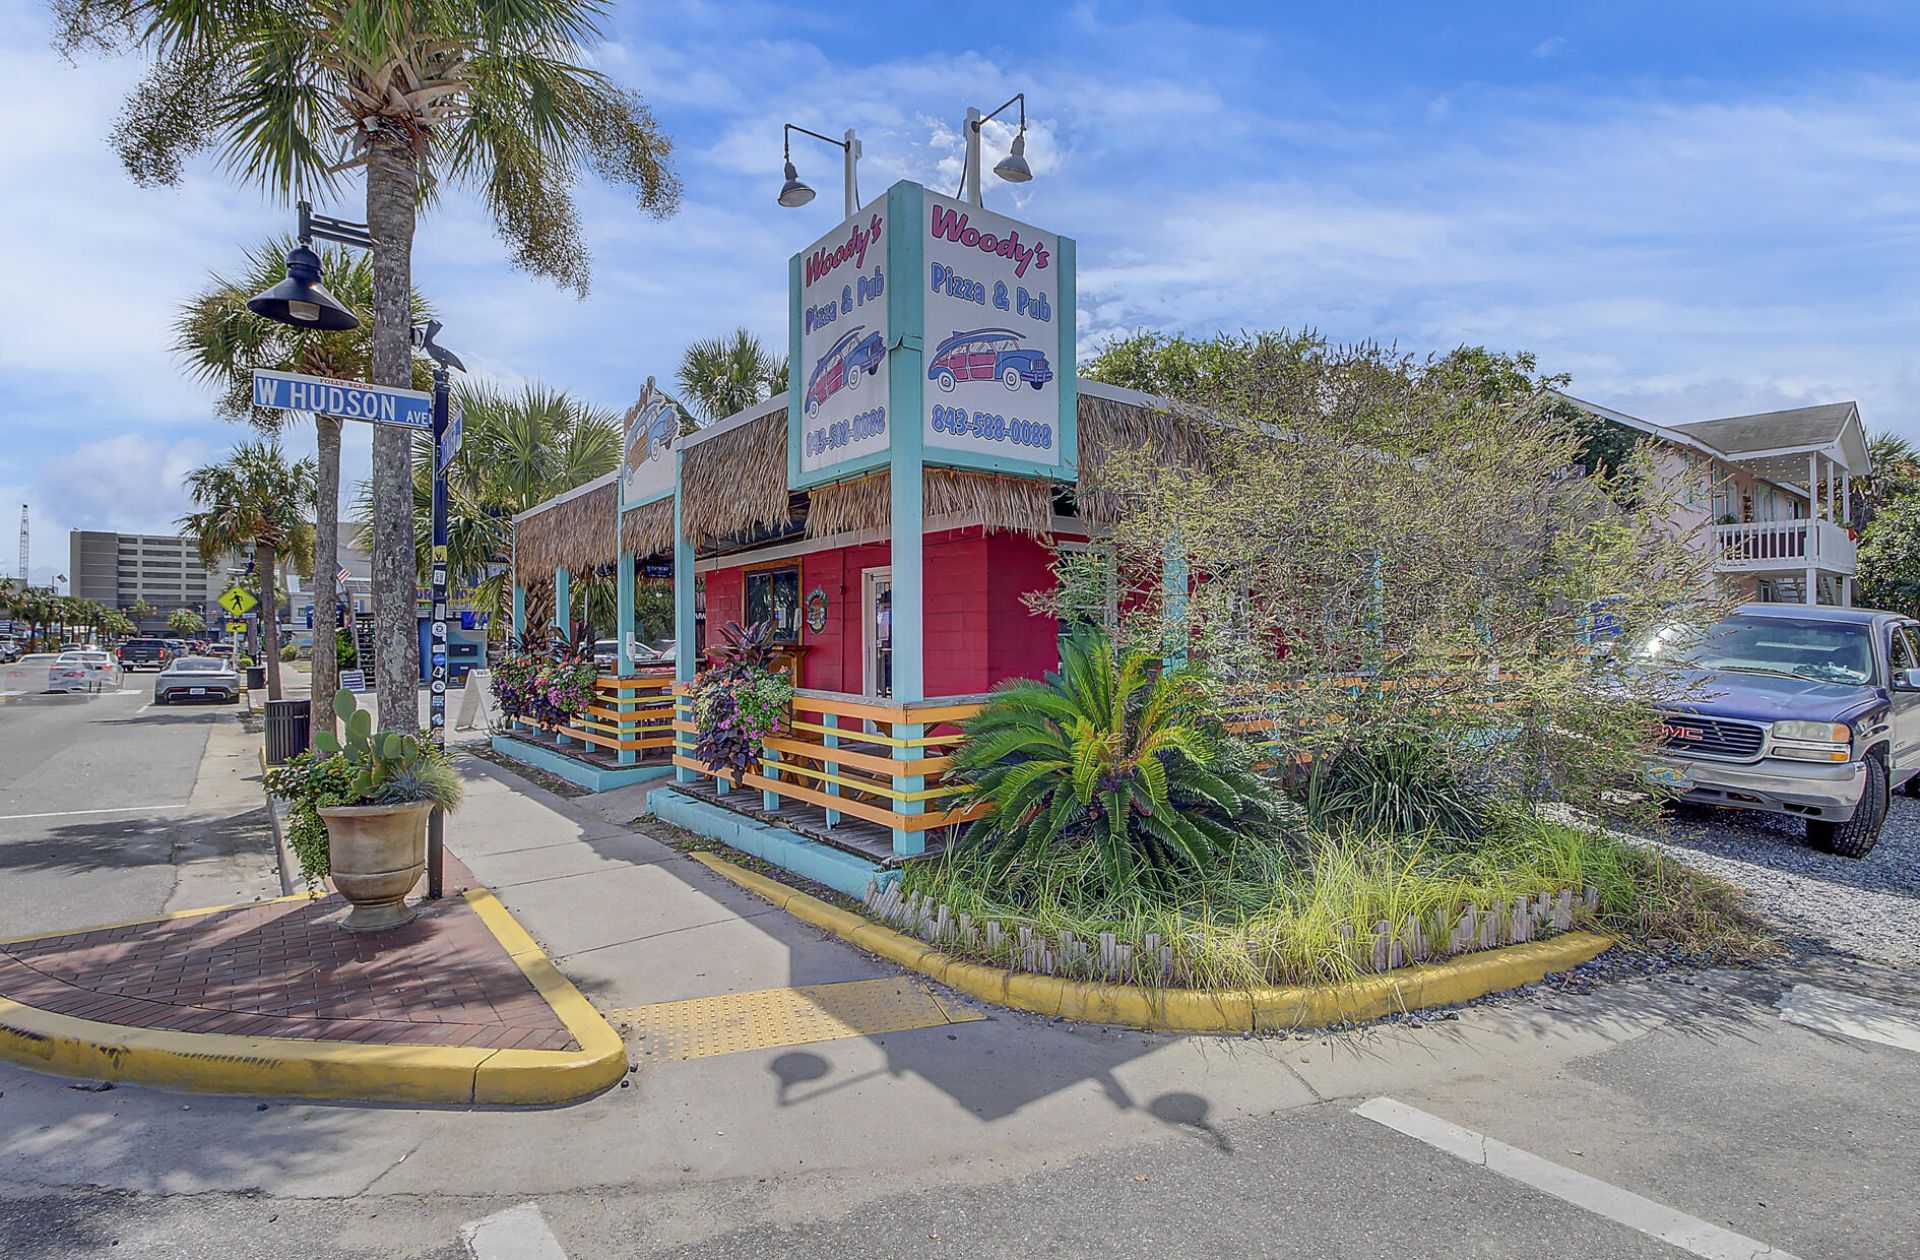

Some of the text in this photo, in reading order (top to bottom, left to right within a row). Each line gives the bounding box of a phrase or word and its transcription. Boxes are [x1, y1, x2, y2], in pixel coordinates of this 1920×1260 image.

[807, 215, 882, 287] Woody's
[932, 205, 1050, 278] Woody's
[806, 267, 884, 335] Pizza & Pub
[932, 263, 1052, 322] Pizza & Pub
[258, 378, 428, 424] W HUDSON AVE
[932, 405, 1052, 449] 843-588-0088
[807, 406, 886, 457] 843-588-0088
